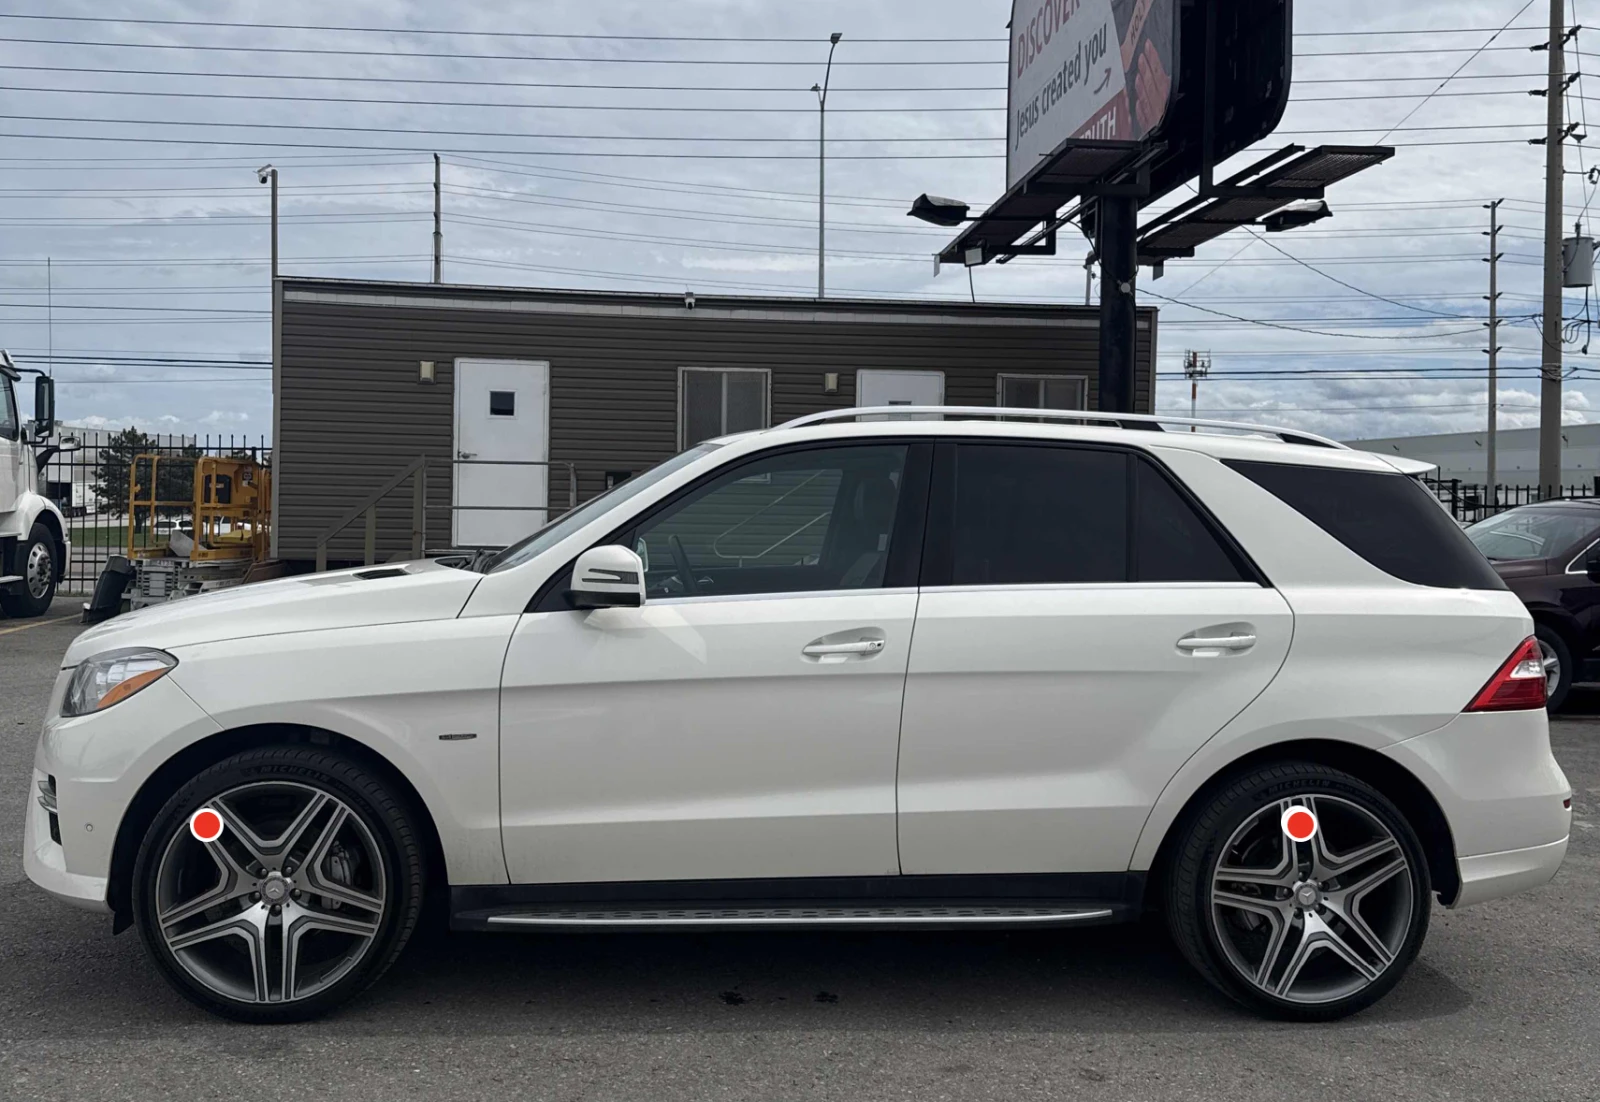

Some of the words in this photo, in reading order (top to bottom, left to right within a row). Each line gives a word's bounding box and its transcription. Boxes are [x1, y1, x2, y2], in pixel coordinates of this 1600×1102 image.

[1014, 95, 1039, 152] Jesus
[1041, 40, 1081, 115] created
[1084, 22, 1107, 86] you
[1079, 106, 1116, 140] UTH
[260, 764, 330, 782] MICHELIN
[1268, 779, 1331, 793] MICHELIN
